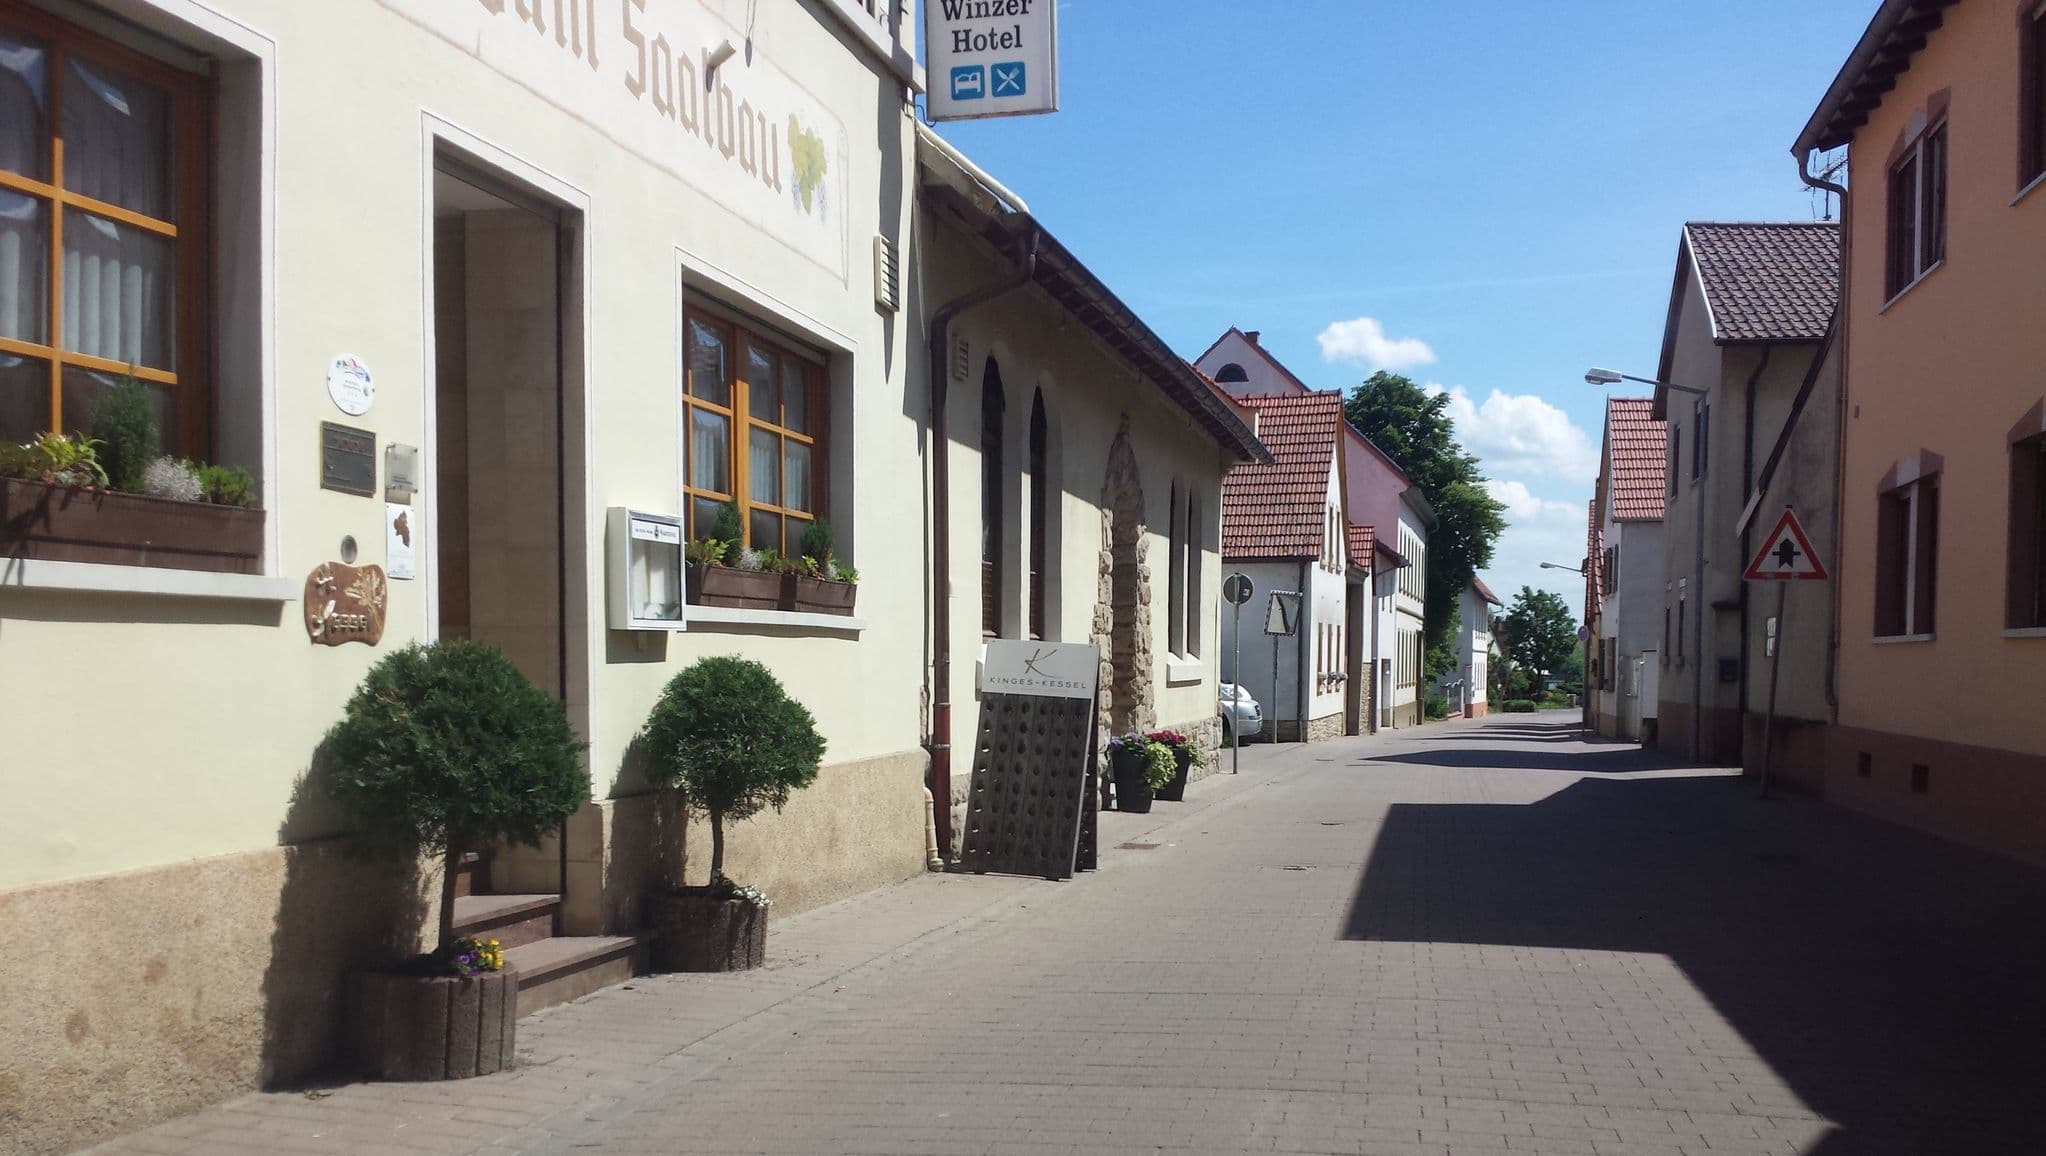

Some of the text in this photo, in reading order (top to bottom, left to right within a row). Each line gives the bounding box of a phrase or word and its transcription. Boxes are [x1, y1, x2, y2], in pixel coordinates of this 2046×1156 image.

[942, 0, 1032, 21] Winzer
[952, 25, 1023, 53] Hotel
[990, 677, 1087, 689] KINGES-KESSEL
